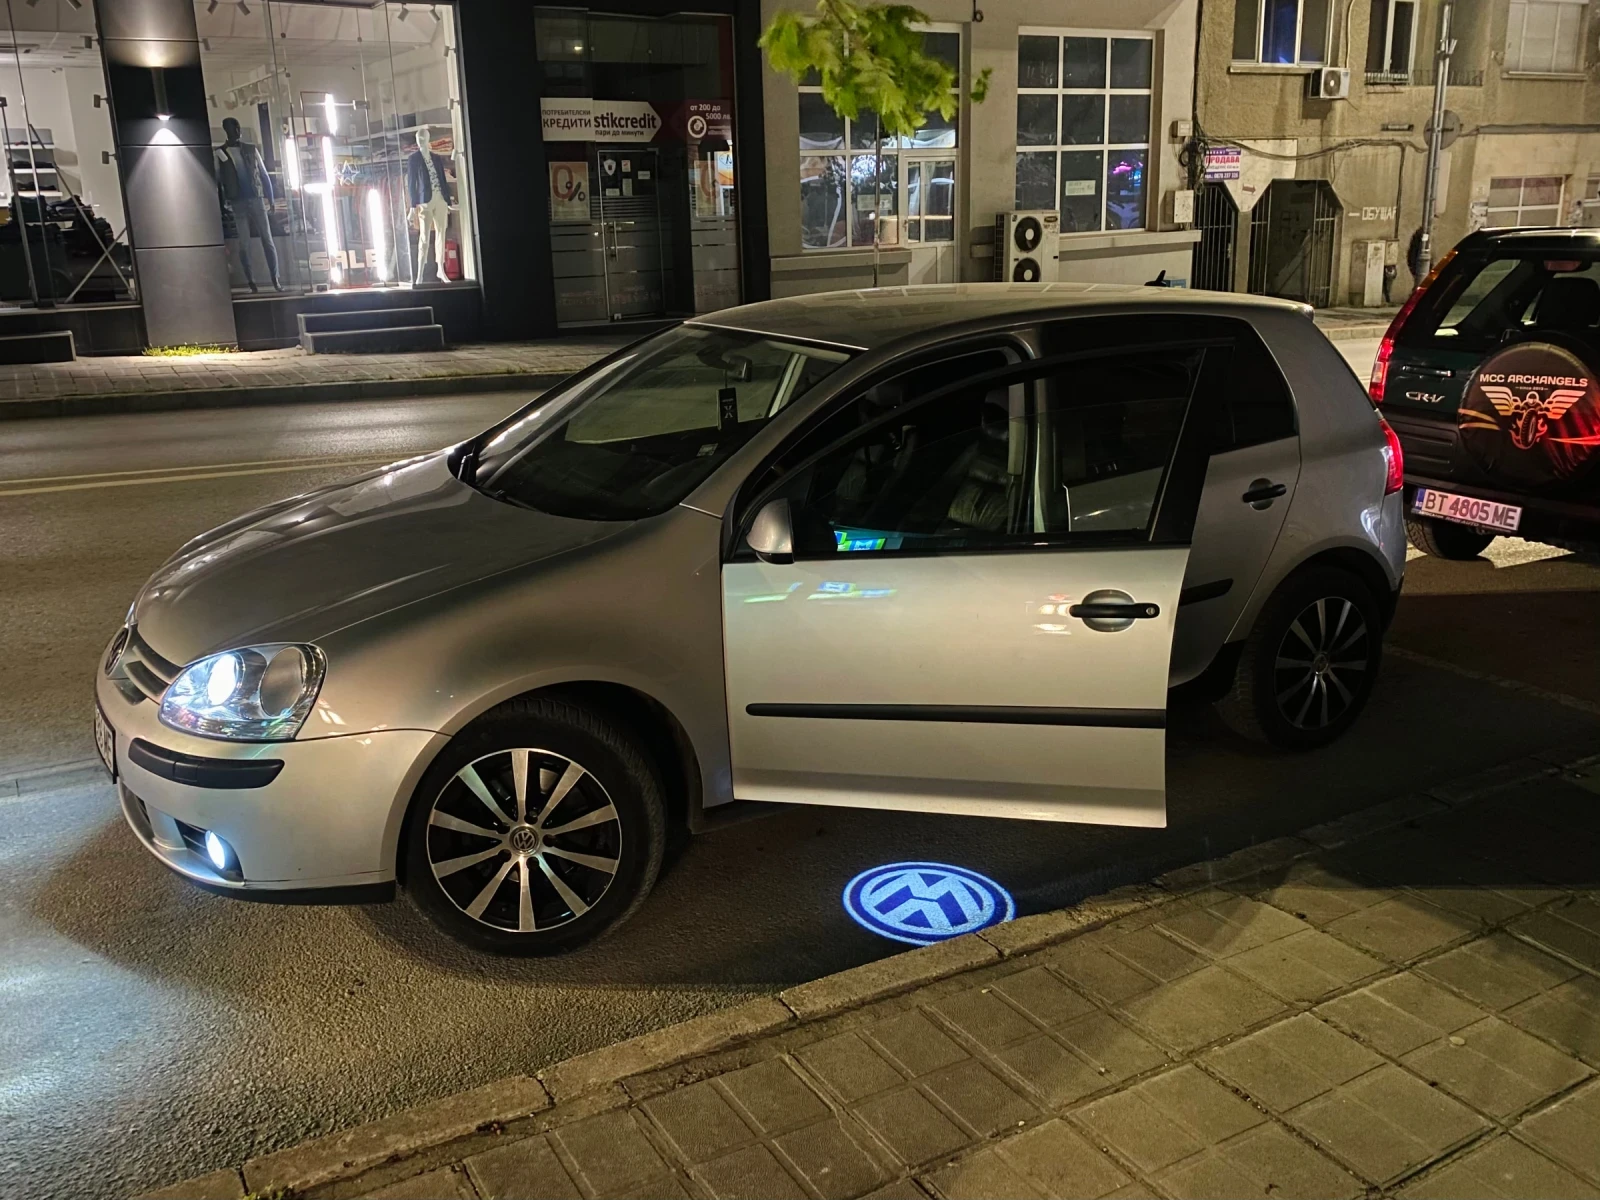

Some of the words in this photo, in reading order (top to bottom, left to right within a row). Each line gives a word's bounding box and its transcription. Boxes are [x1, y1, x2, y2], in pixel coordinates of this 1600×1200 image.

[699, 103, 711, 111] 200
[594, 112, 657, 129] stikcredit
[705, 112, 722, 120] 5000
[543, 118, 592, 130] КРЕДИТИ
[1205, 156, 1240, 164] ПРОДАВА
[309, 249, 378, 272] SALE
[1480, 373, 1506, 383] MCC
[1507, 374, 1589, 388] ARCHANGELS
[1405, 391, 1446, 403] CR-V
[1425, 491, 1449, 512] BT
[1449, 497, 1491, 522] 4805
[1491, 504, 1518, 528] ME
